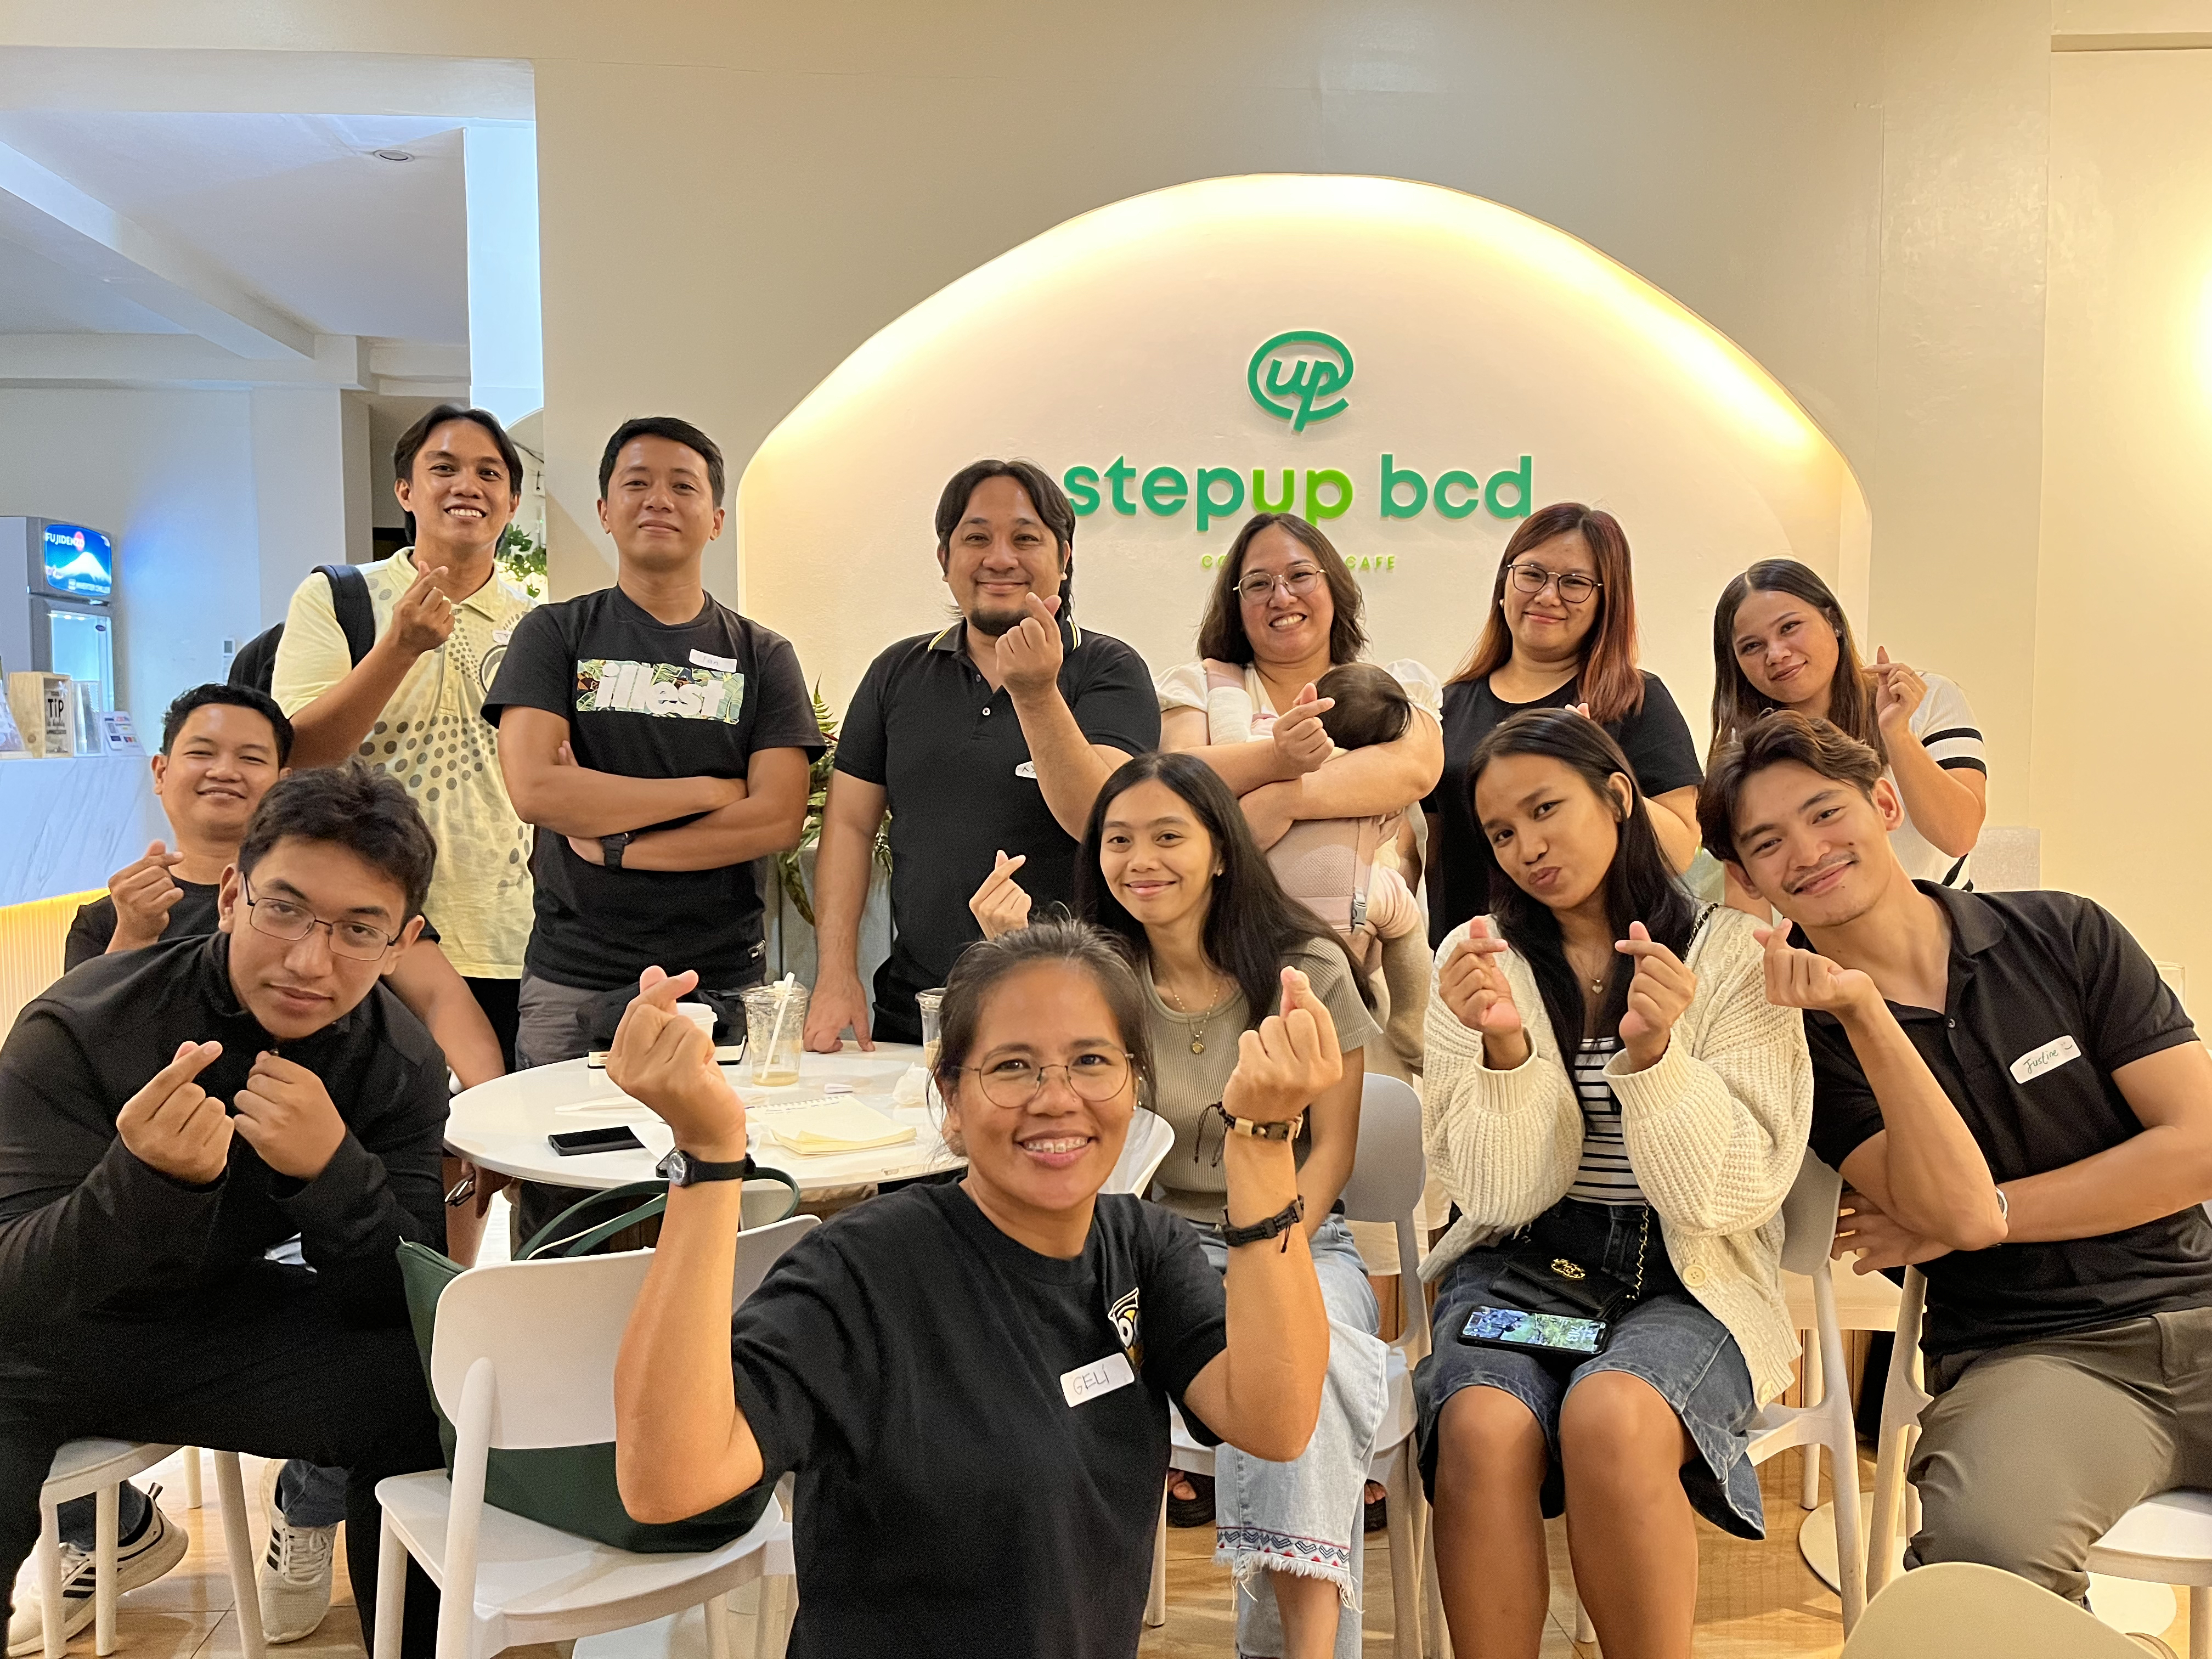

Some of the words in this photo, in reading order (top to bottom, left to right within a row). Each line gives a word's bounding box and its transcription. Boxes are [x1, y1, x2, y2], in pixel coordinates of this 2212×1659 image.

[1063, 455, 1353, 532] stepup
[1380, 454, 1532, 518] bcd
[1345, 555, 1395, 569] CAFE
[595, 663, 726, 717] illest
[2023, 1049, 2059, 1074] Justine
